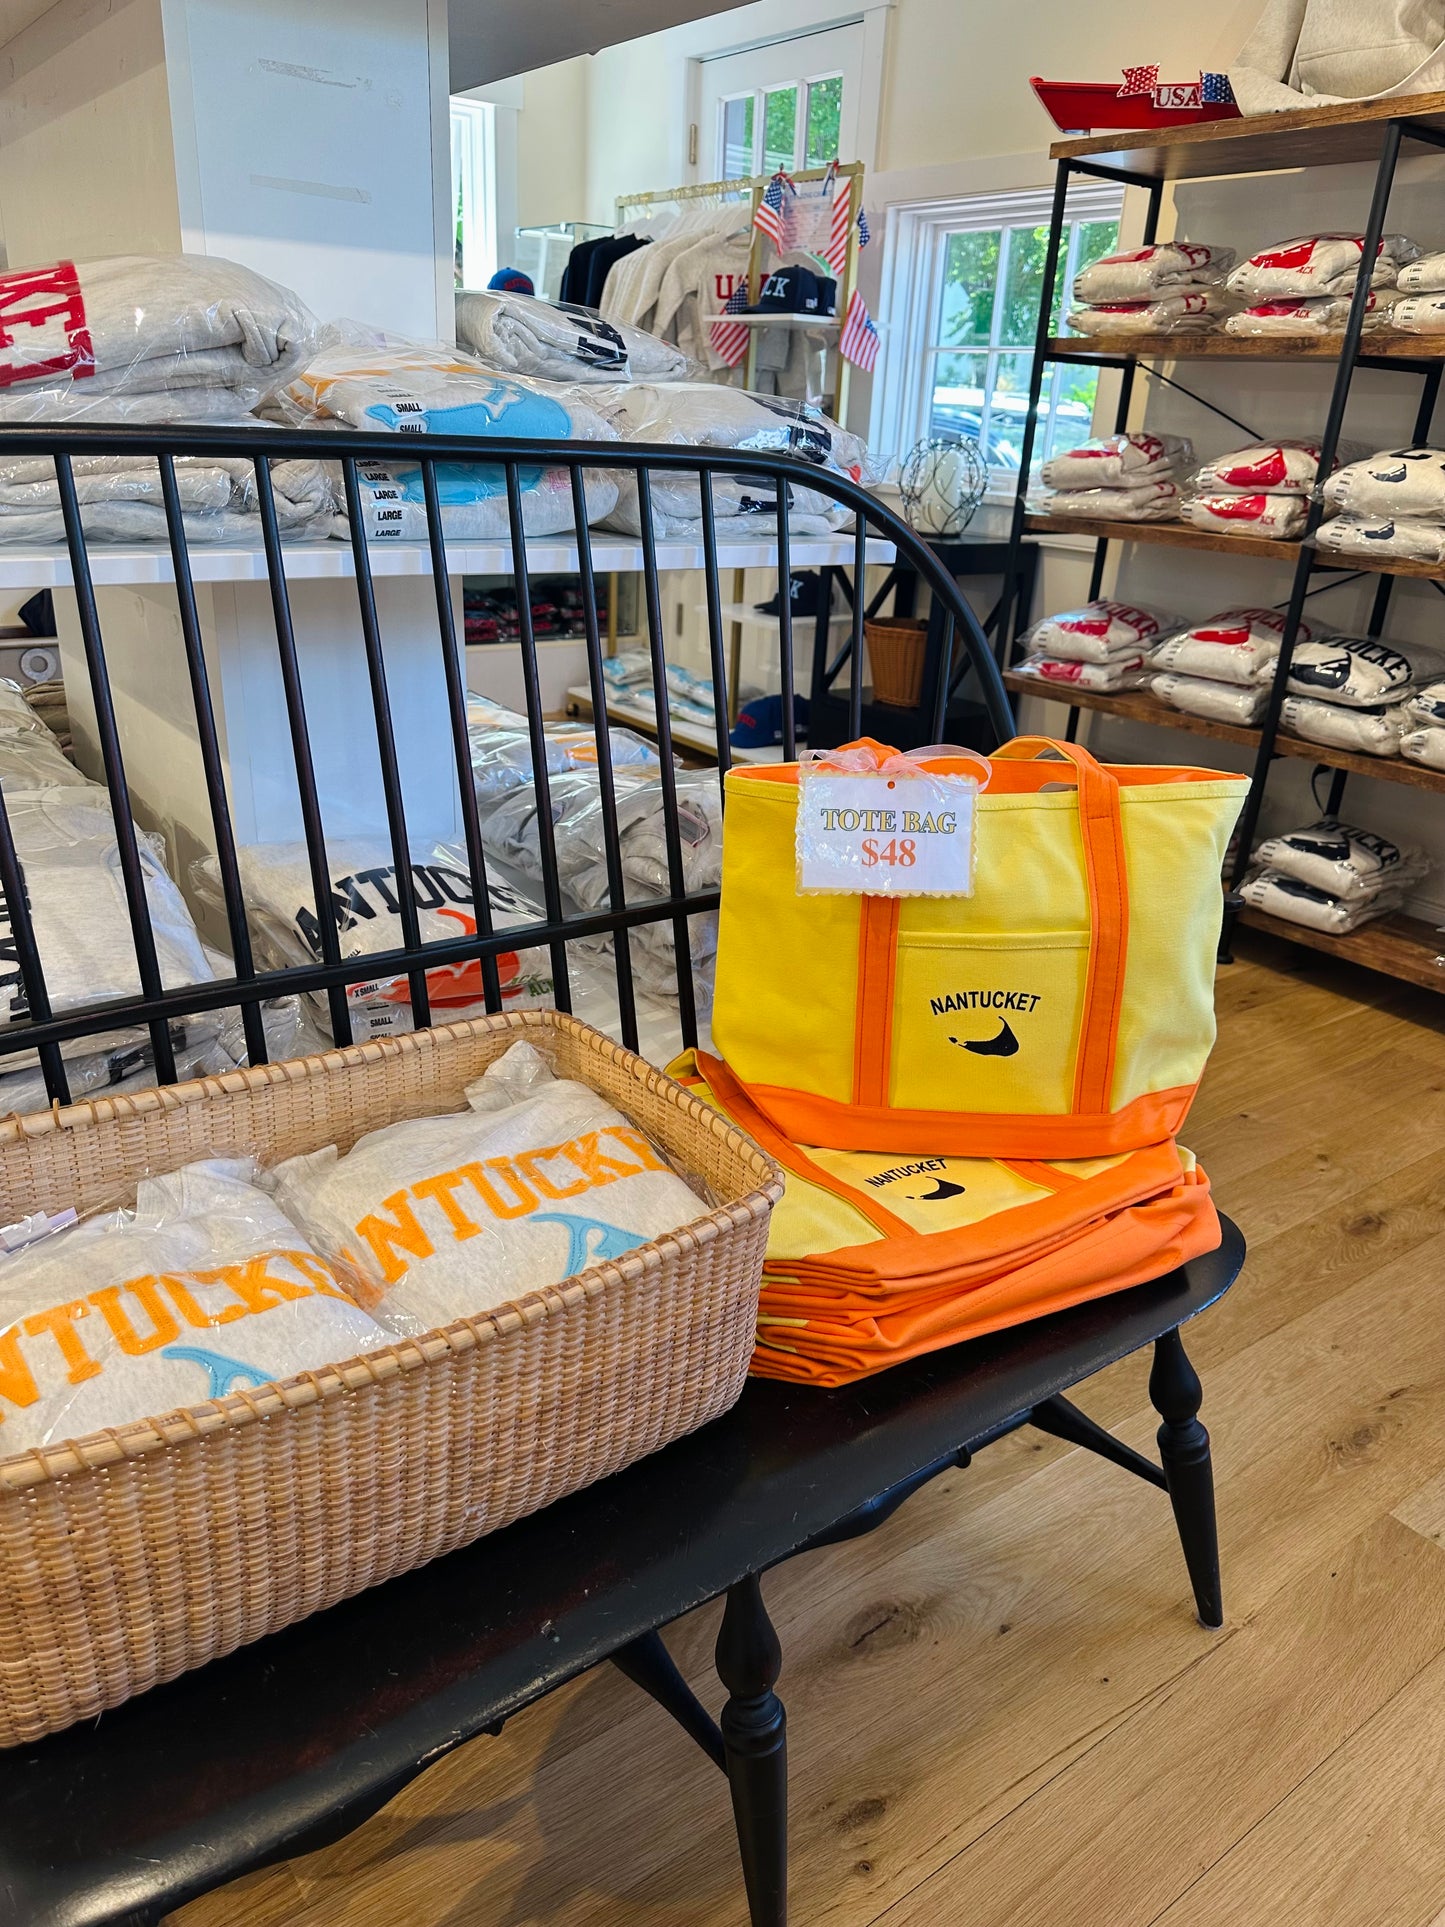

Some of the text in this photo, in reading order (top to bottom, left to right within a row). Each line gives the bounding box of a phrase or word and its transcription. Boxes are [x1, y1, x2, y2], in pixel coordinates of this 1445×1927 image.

[1156, 86, 1201, 107] USA
[396, 403, 422, 412] SMALL
[365, 473, 389, 481] LARGE
[374, 490, 398, 499] LARGE
[378, 510, 402, 520] LARGE
[1259, 516, 1276, 526] ACK
[821, 808, 957, 834] TOTE BAG
[861, 837, 916, 868] $48
[354, 984, 379, 998] X SMALL
[930, 991, 1041, 1015] NANTUCKET
[370, 1017, 393, 1027] SMALL
[864, 1158, 947, 1188] NANTUCKET
